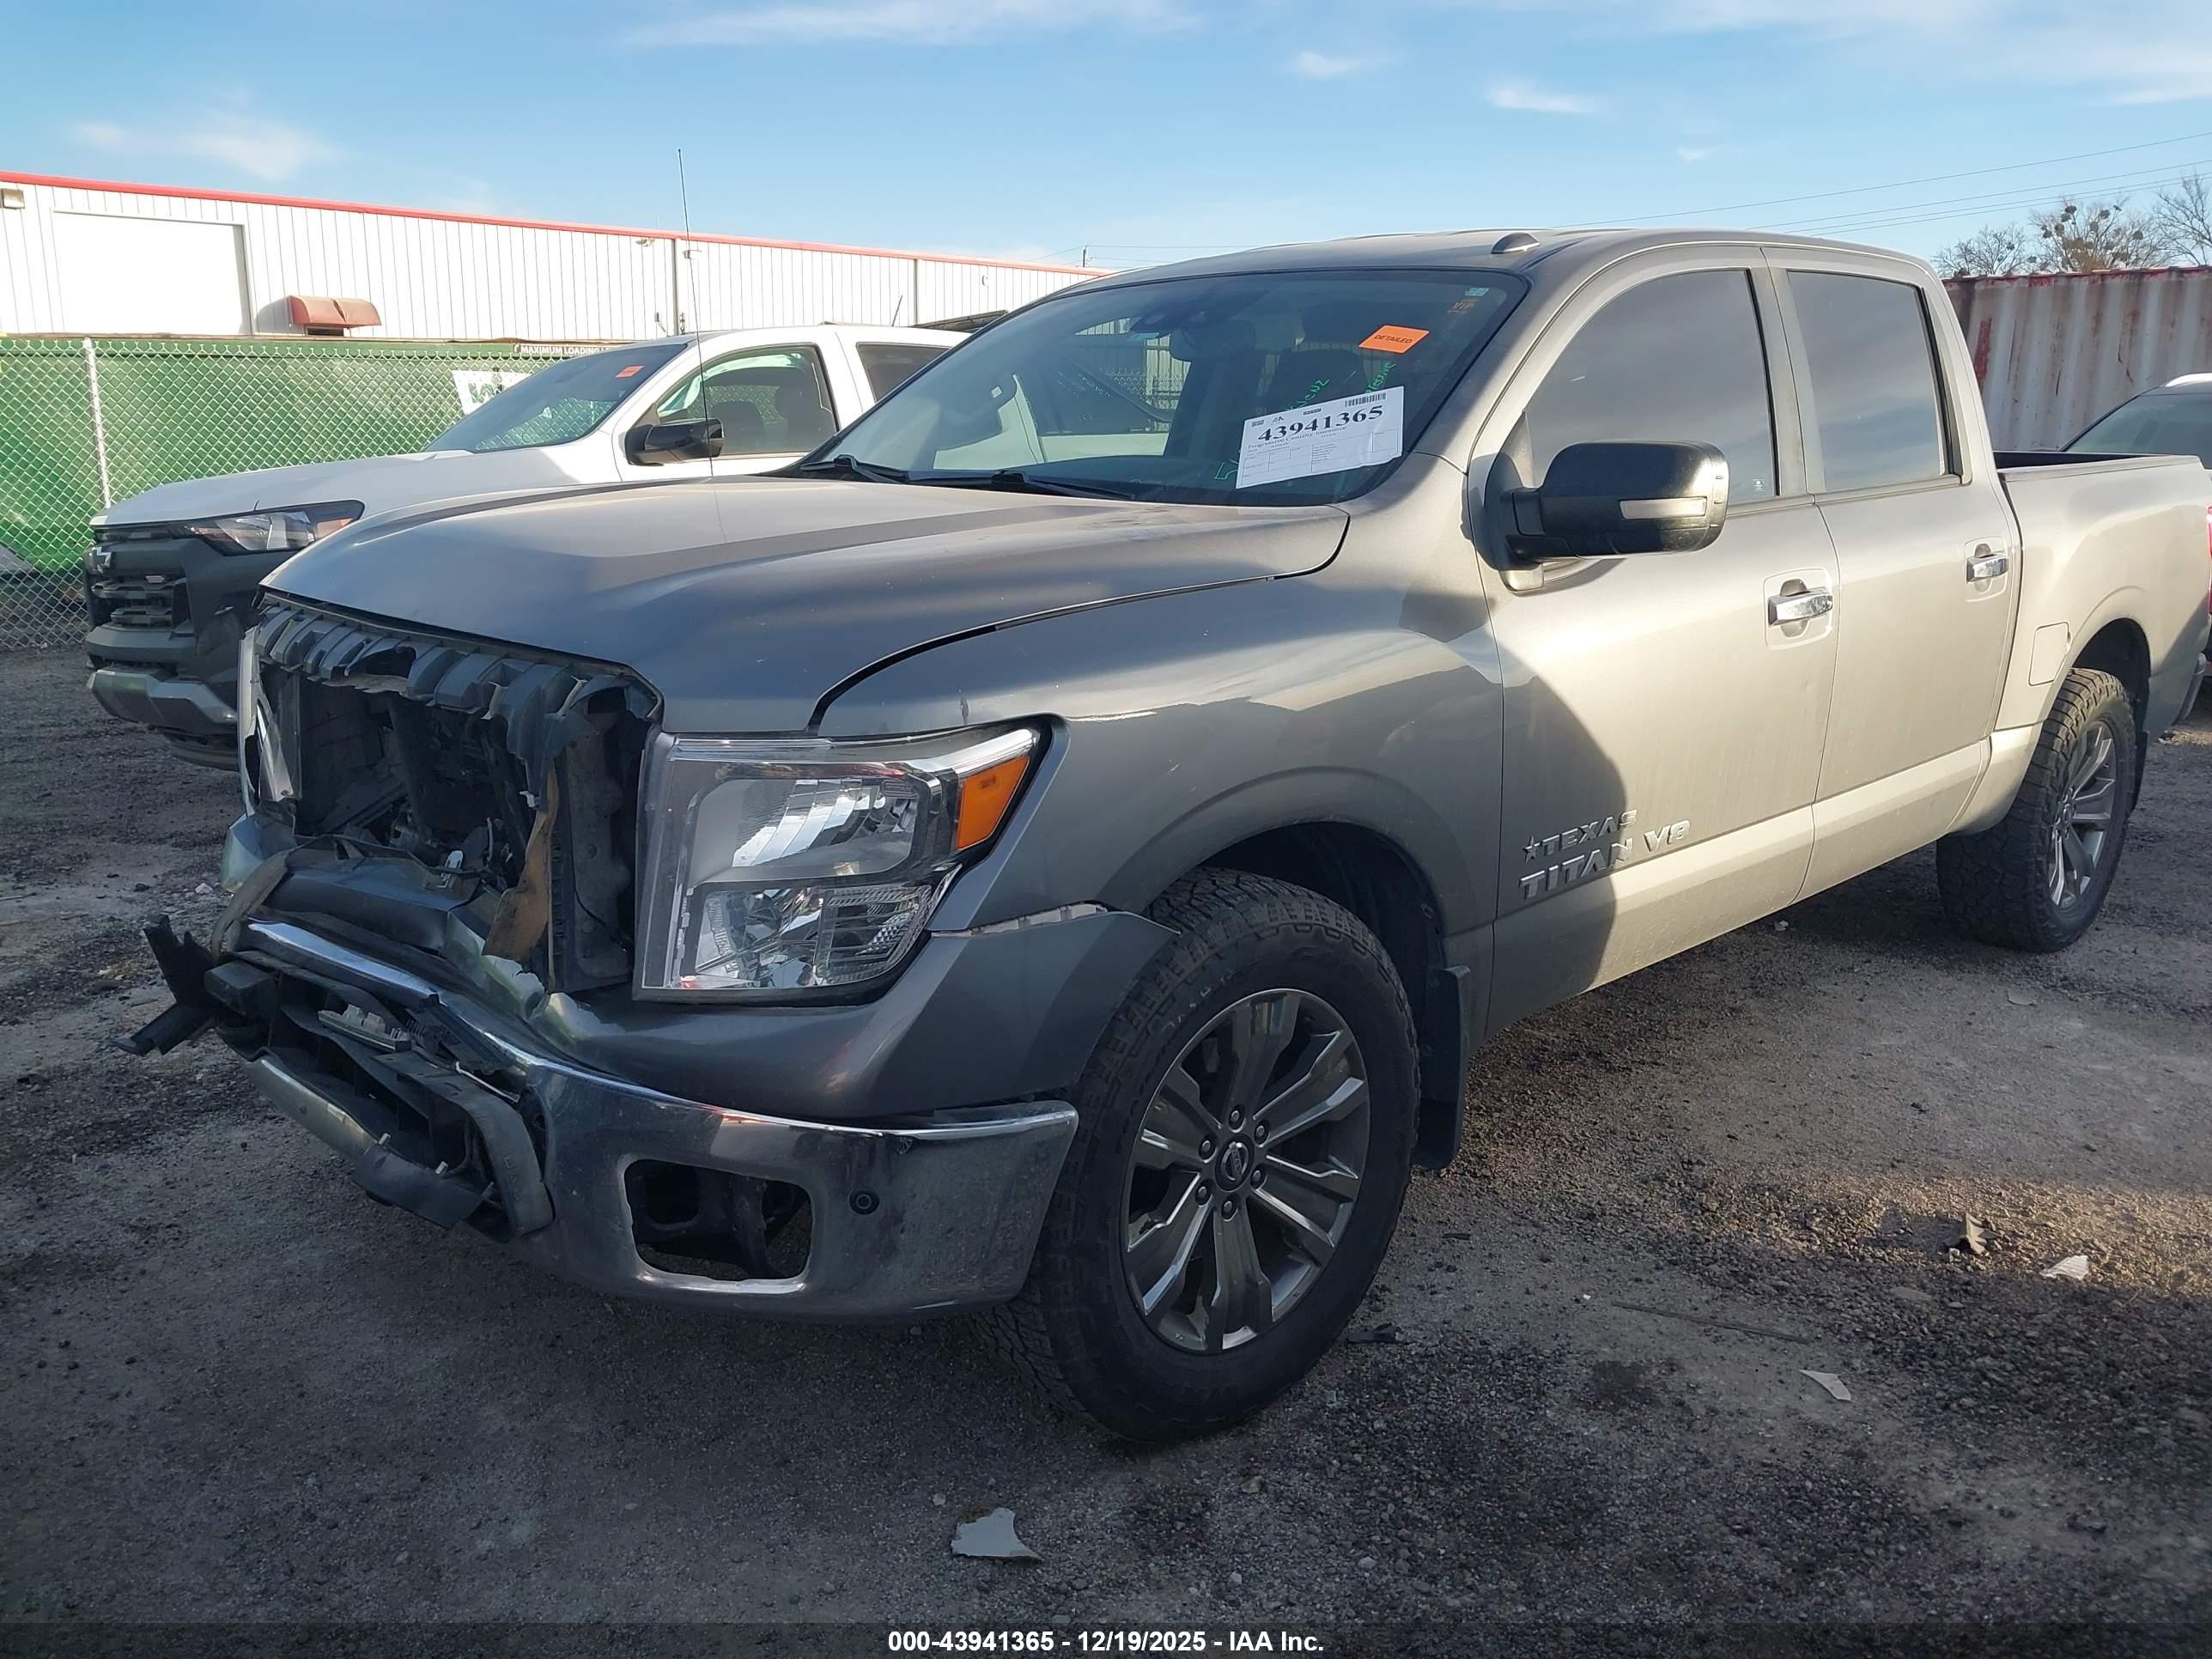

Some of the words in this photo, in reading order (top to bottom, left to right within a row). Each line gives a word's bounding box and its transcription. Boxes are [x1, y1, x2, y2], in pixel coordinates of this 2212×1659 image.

[520, 346, 562, 355] MAXIMUM
[564, 346, 600, 356] LOADING
[1374, 333, 1413, 344] DETAILED
[1258, 405, 1383, 441] 43941365
[1542, 810, 1638, 856] TEXAS
[1519, 838, 1633, 900] TITAN
[1644, 819, 1691, 853] V8
